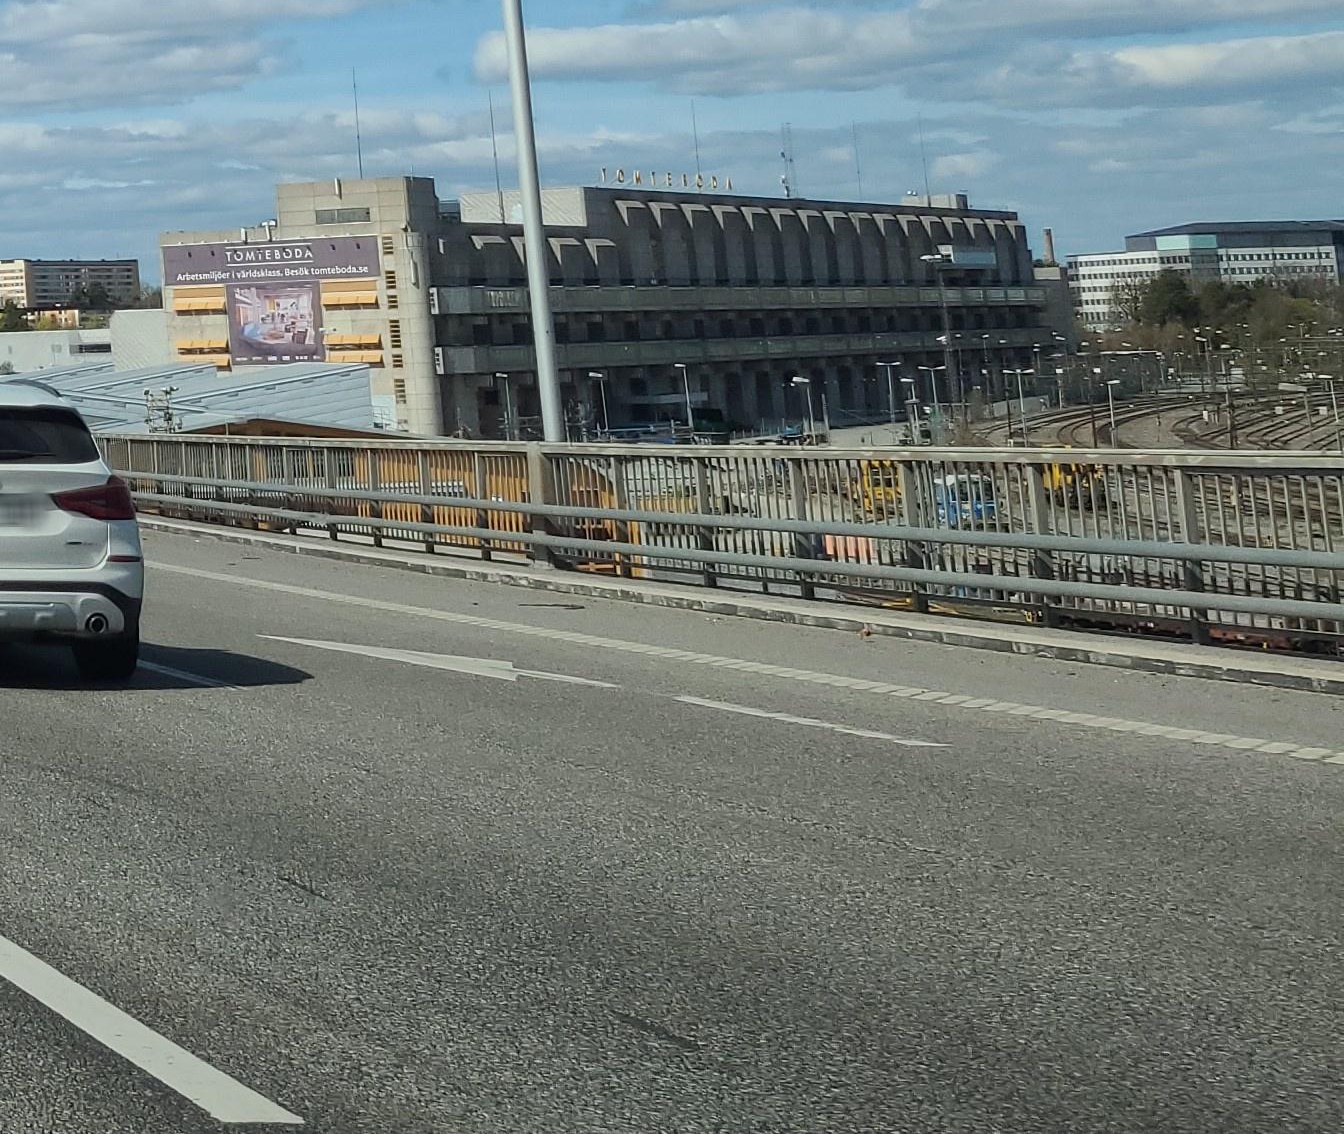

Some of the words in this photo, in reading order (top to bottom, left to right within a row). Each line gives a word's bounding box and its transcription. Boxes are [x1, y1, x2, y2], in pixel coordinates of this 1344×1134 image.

[225, 248, 313, 262] TOMTEBODA
[177, 271, 230, 282] Arbetsmiljöer
[236, 268, 283, 278] världsklass.
[285, 267, 309, 276] Besök
[311, 265, 368, 275] tomteboda.se
